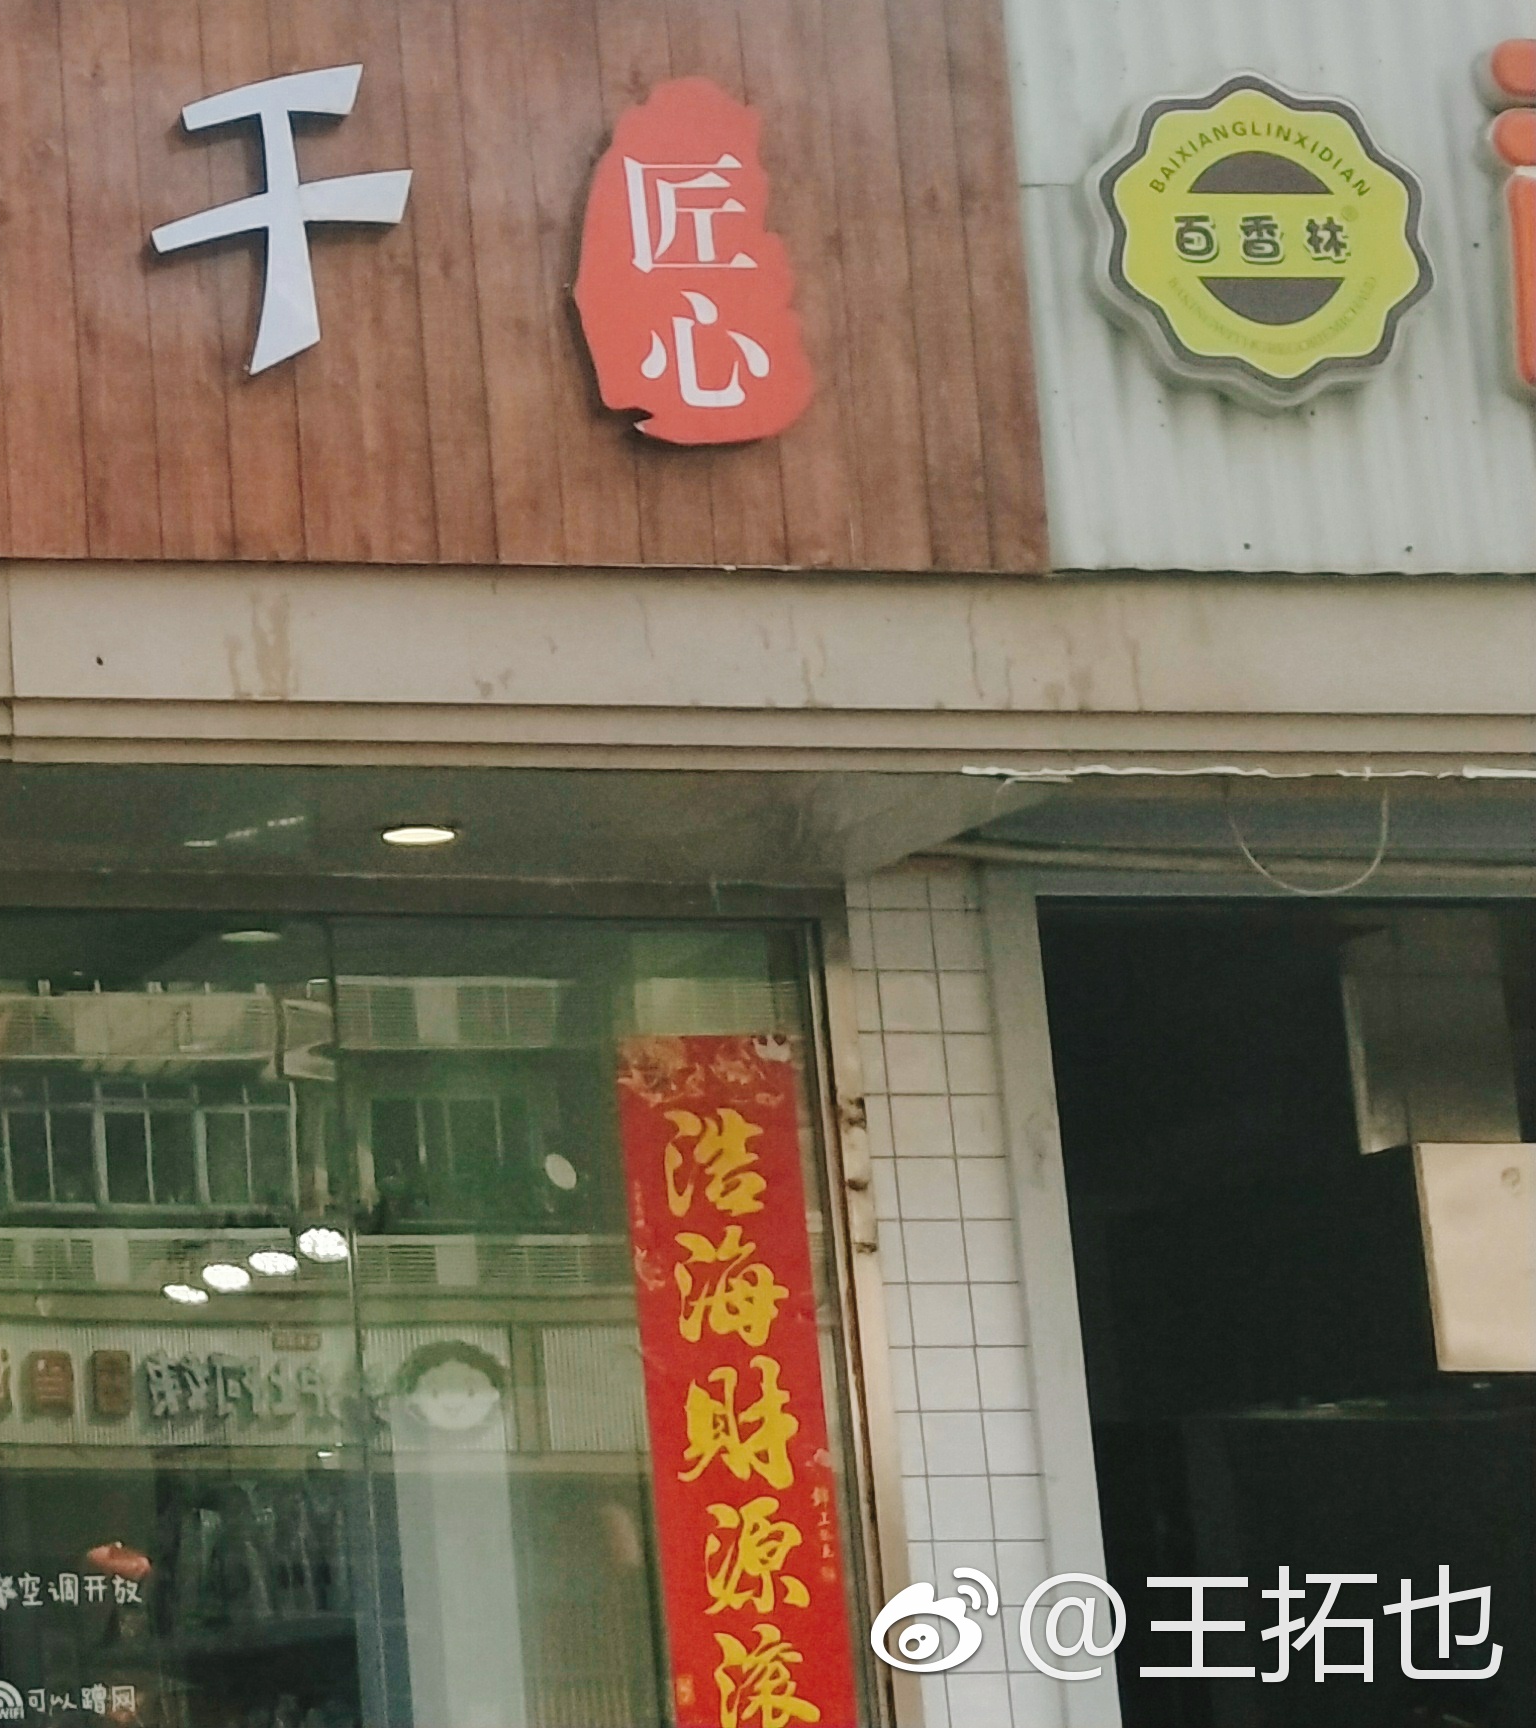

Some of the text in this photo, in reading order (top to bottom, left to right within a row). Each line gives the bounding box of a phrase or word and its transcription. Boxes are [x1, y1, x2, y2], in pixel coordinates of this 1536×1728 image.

[1149, 120, 1371, 198] BAIXIANGLINXIDIAN
[1174, 214, 1352, 265] 百香林
[623, 152, 770, 408] 匠心
[18, 1572, 143, 1607] 空调开放
[28, 1683, 136, 1716] 可以蹭网
